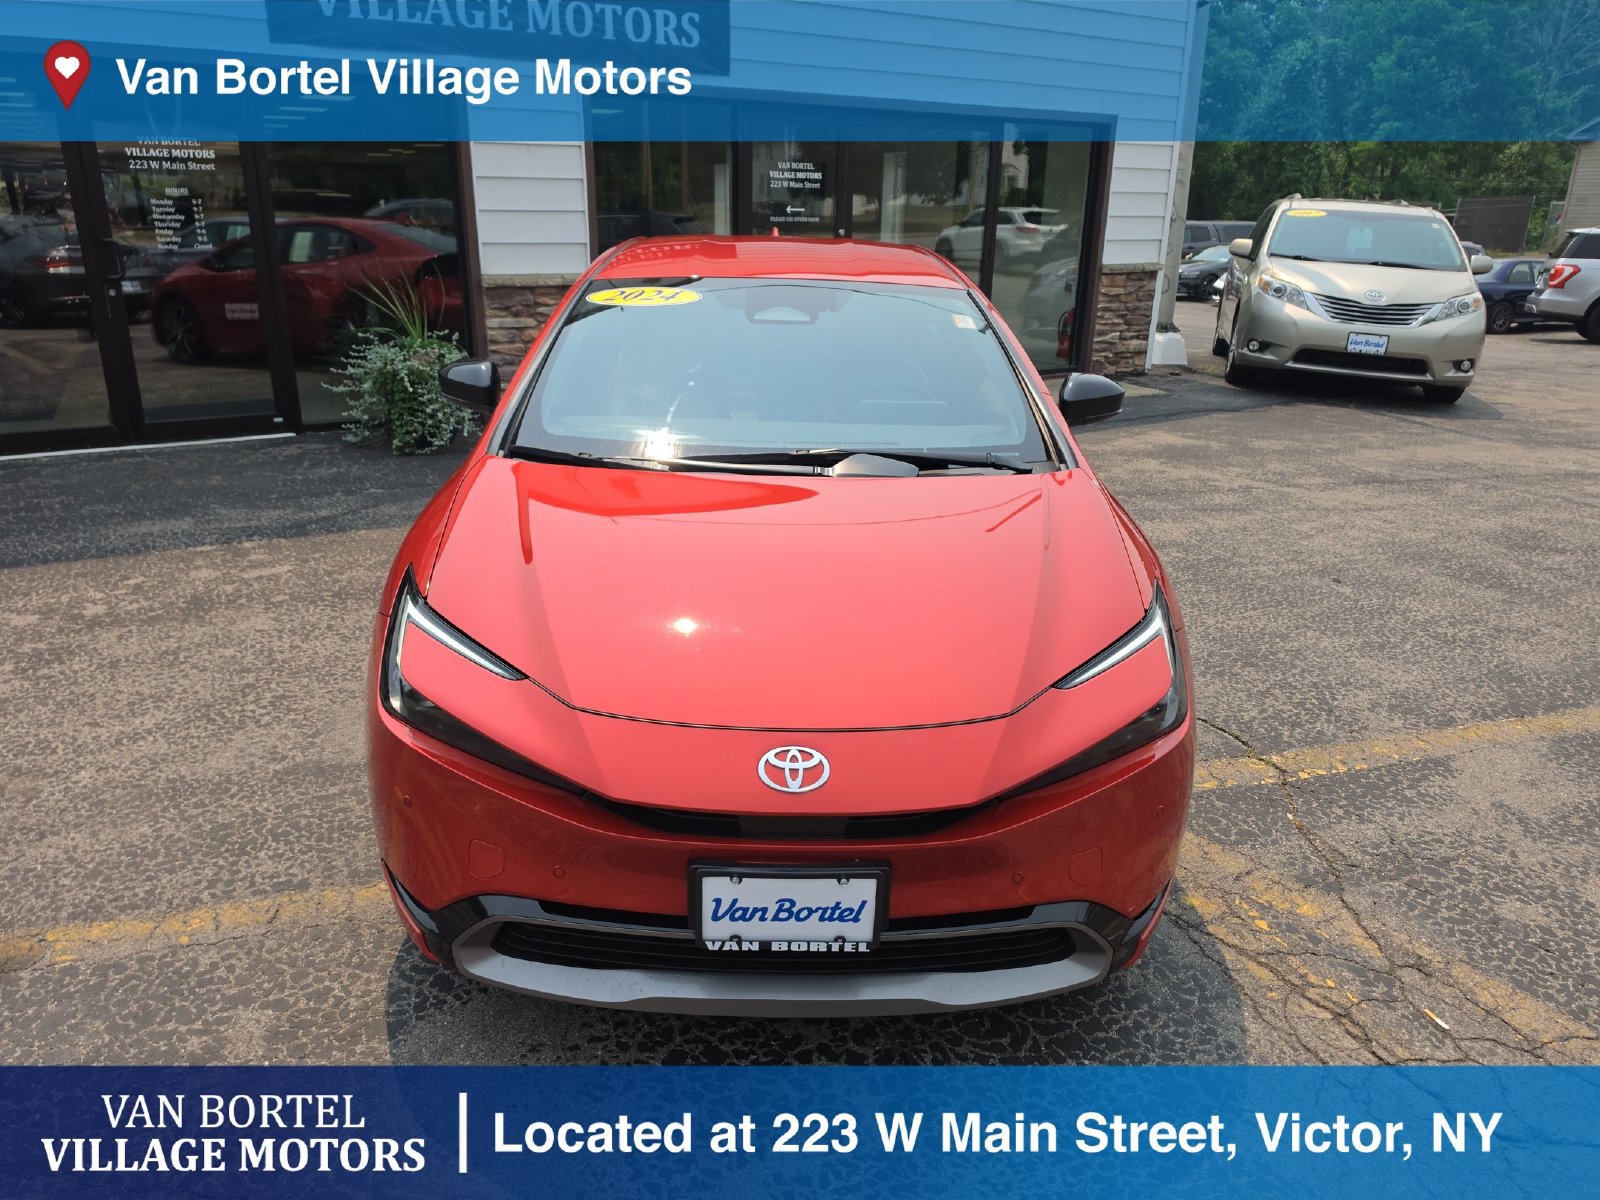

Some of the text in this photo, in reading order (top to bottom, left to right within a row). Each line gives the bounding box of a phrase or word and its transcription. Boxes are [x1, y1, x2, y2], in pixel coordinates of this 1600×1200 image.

[526, 0, 701, 48] MOTORS
[125, 147, 215, 159] VILLAGE MOTORS
[128, 160, 216, 170] 223 W Main Street
[778, 161, 815, 170] VAN BORTEL
[769, 170, 822, 180] VILLAGE MOTORS
[770, 180, 781, 188] 223
[165, 187, 189, 195] HOURS
[150, 198, 173, 206] Monday
[152, 213, 185, 221] Wednesday
[601, 290, 683, 301] 2024
[711, 897, 868, 924] Van Bortel
[705, 941, 871, 953] VAN BORTEL
